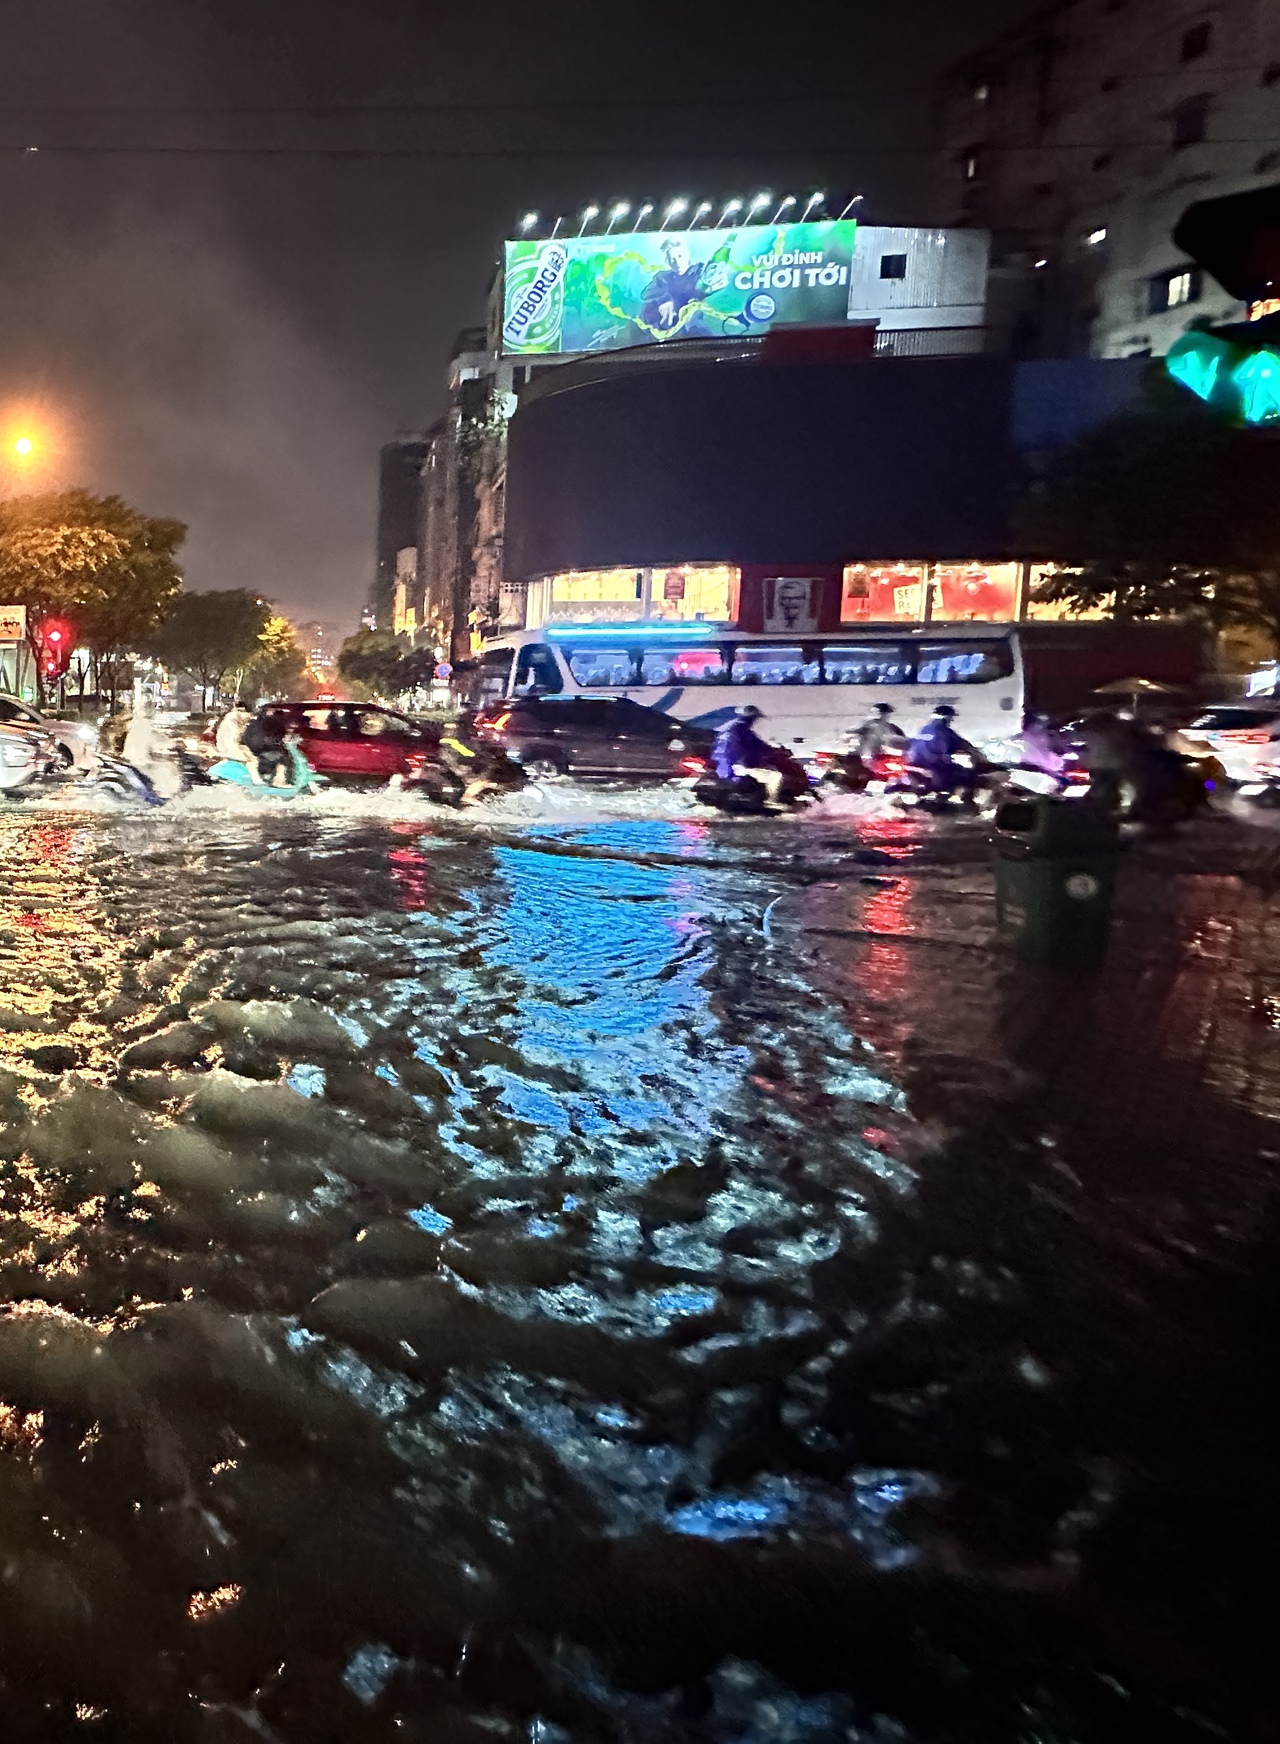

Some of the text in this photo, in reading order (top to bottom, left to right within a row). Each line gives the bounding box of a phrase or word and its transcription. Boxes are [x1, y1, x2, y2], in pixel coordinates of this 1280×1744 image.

[734, 261, 848, 290] CHƠI TỚI
[505, 268, 558, 337] TUBORG
